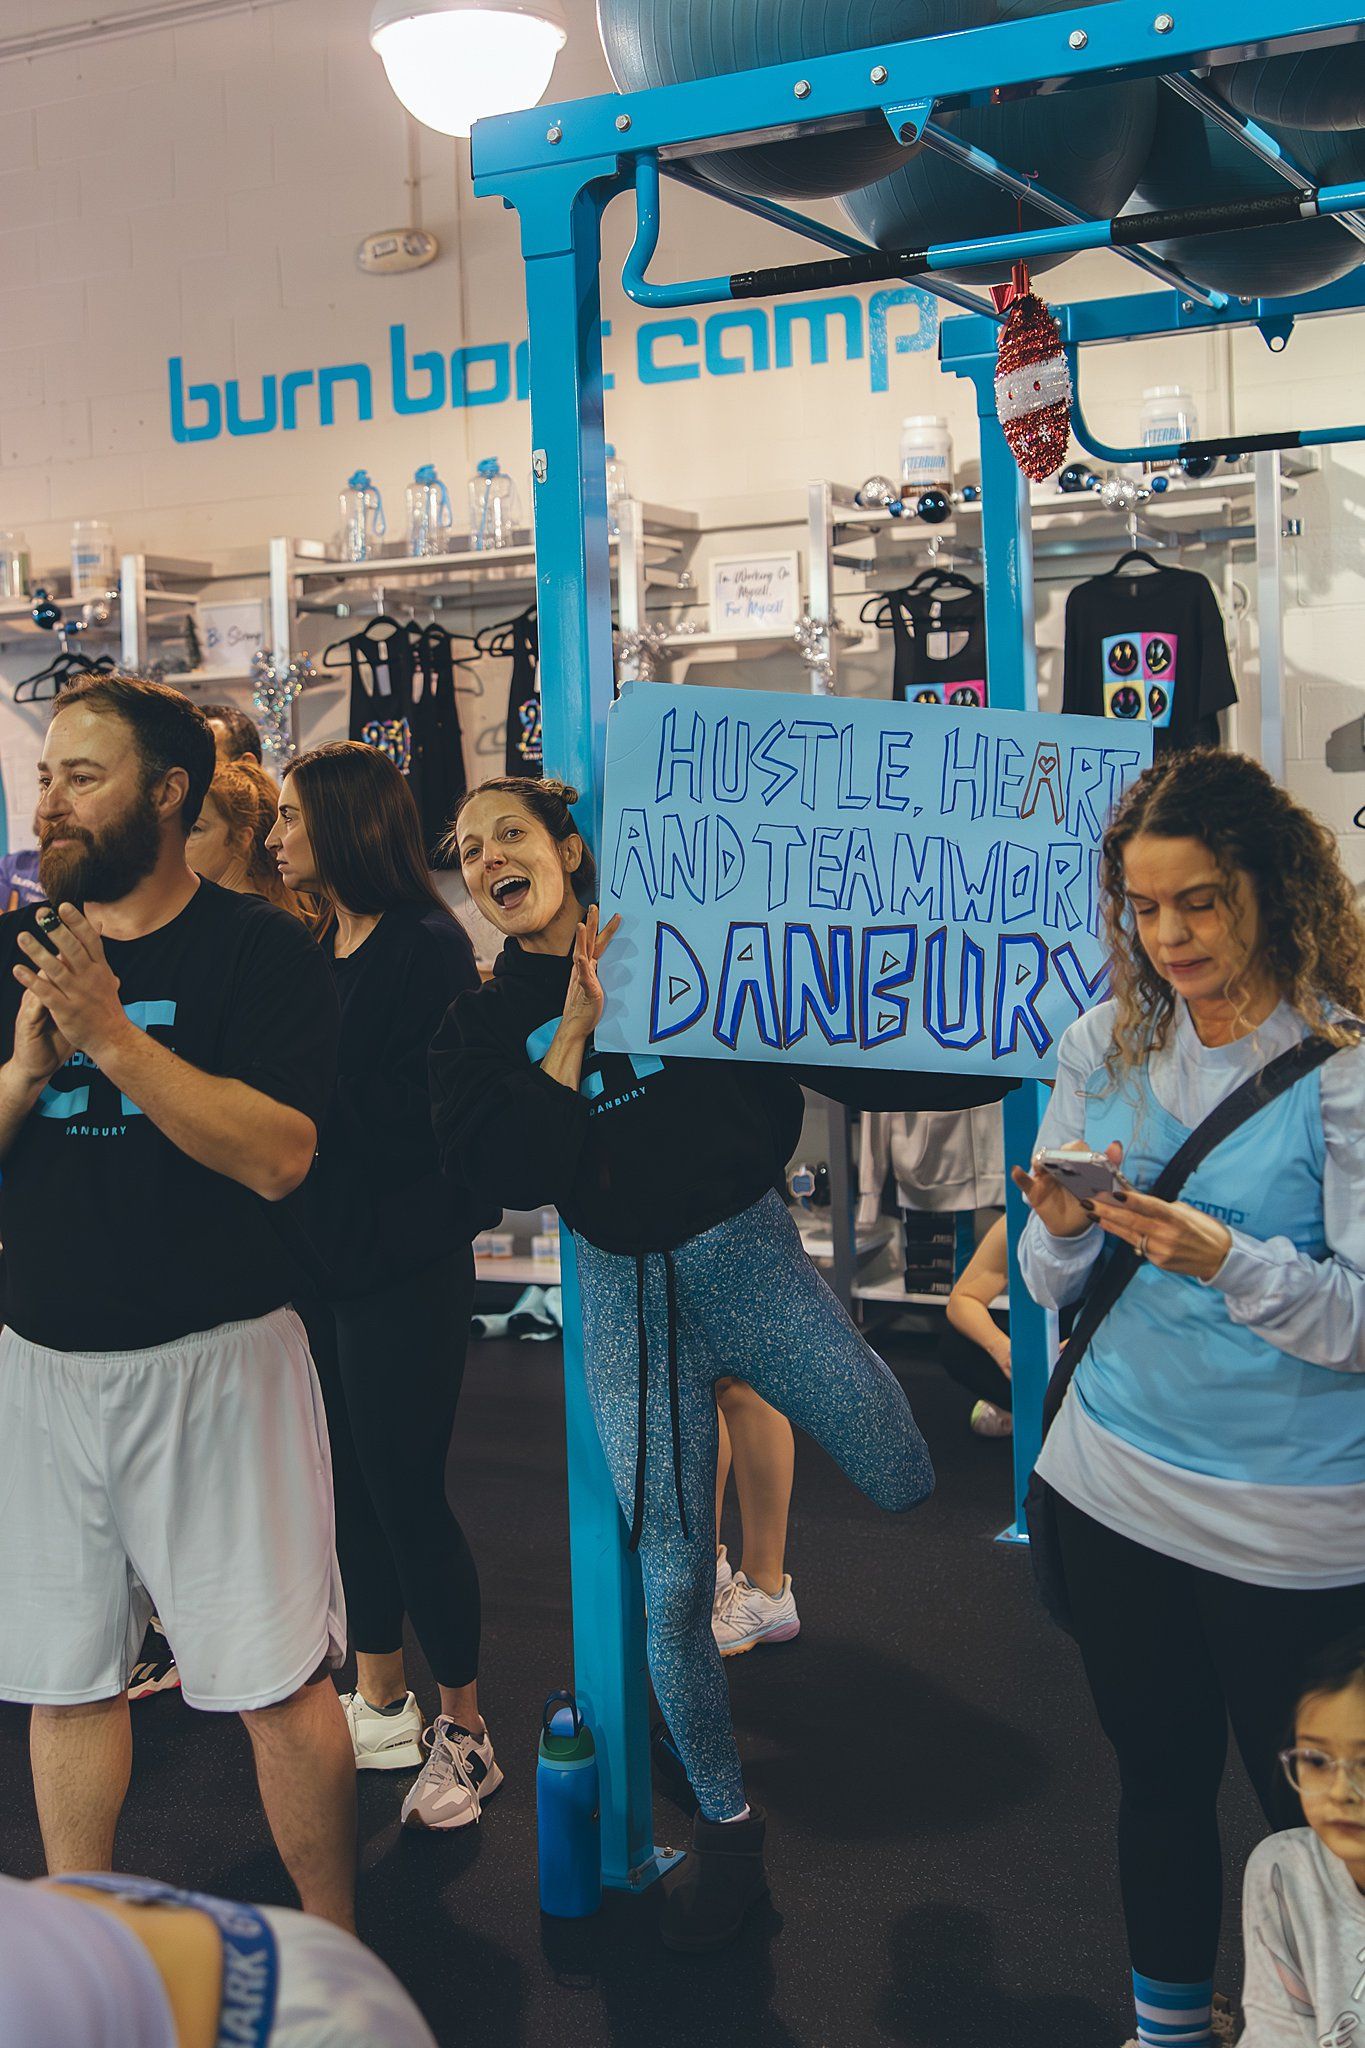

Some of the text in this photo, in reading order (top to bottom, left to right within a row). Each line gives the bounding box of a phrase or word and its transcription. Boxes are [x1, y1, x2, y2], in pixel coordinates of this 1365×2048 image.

[168, 356, 373, 443] burn
[636, 285, 938, 393] camp
[655, 707, 923, 818] HUSTLE,
[940, 727, 1140, 841] HEART
[611, 807, 745, 906] AND
[1181, 1197, 1245, 1225] amp
